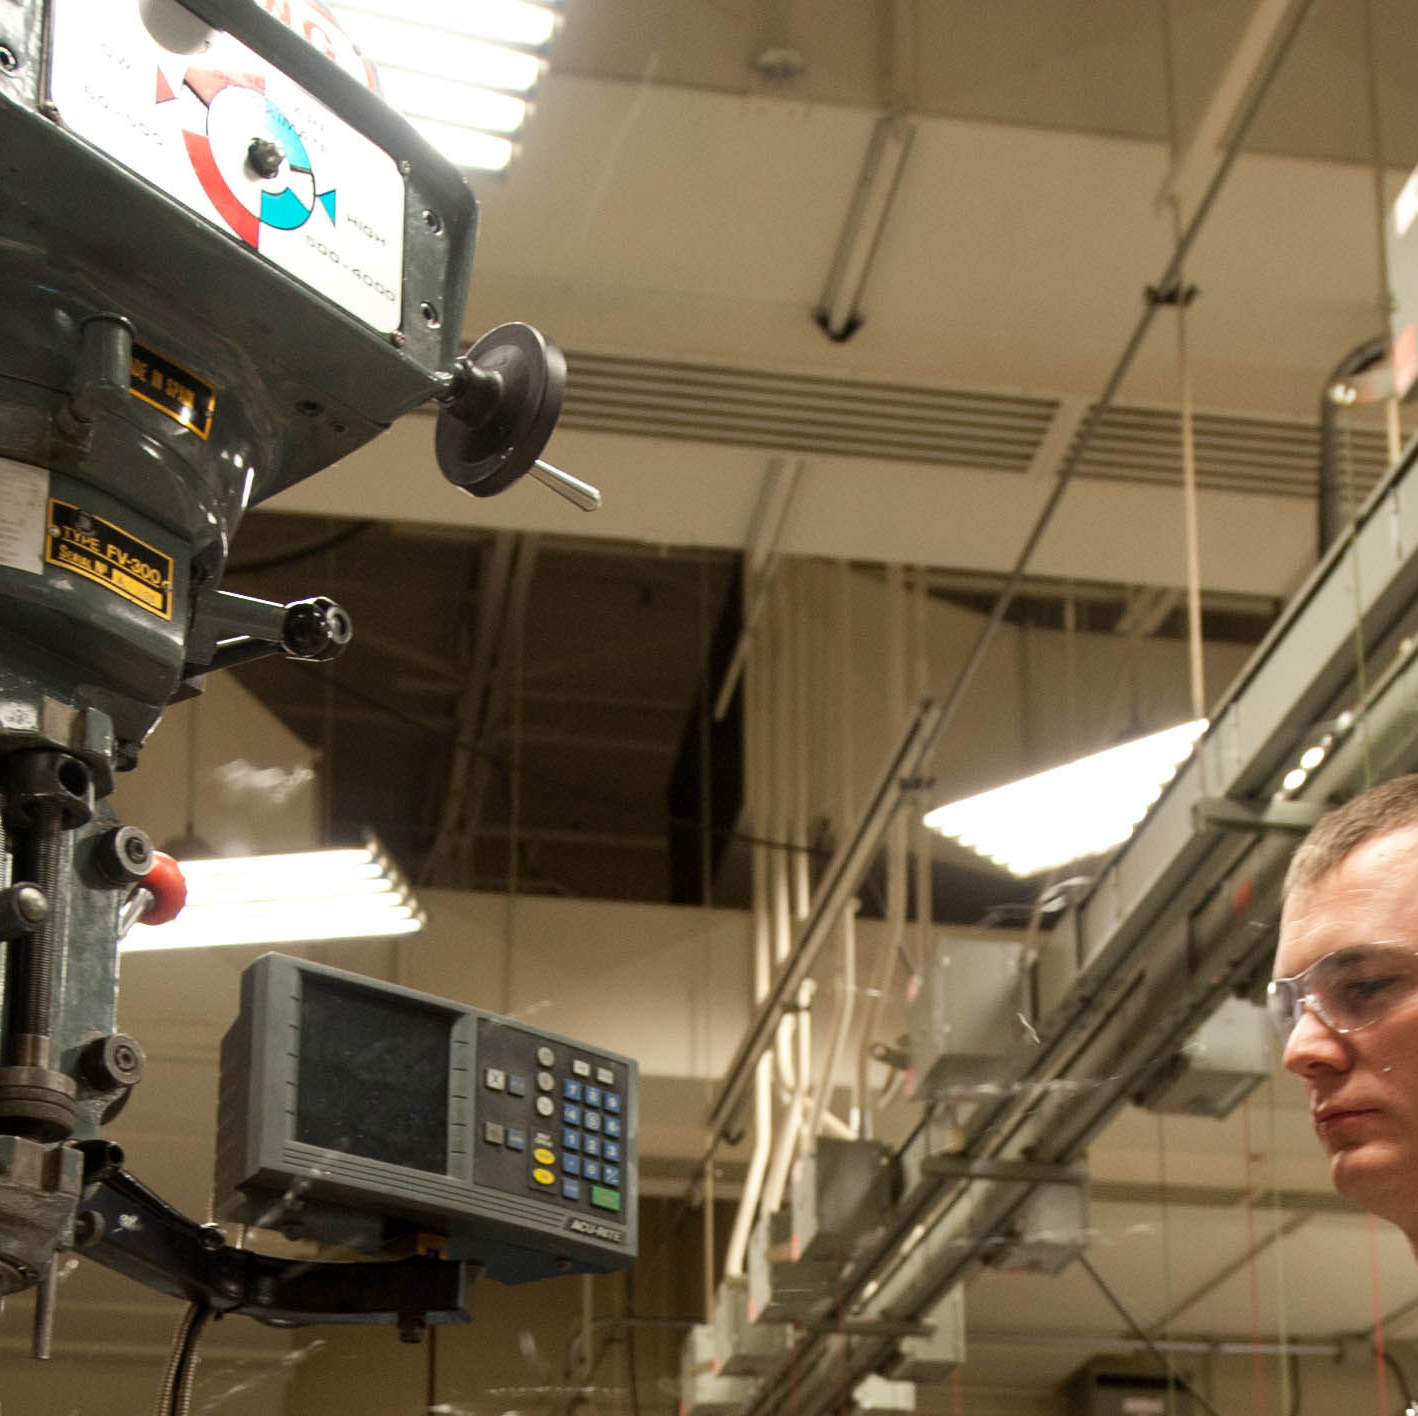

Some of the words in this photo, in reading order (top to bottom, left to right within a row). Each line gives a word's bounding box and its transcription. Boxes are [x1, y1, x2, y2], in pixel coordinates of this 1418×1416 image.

[346, 213, 387, 247] HIGH
[62, 525, 101, 554] TYPE
[106, 543, 162, 585] FV-300
[571, 1219, 622, 1242] ACU-RITE
